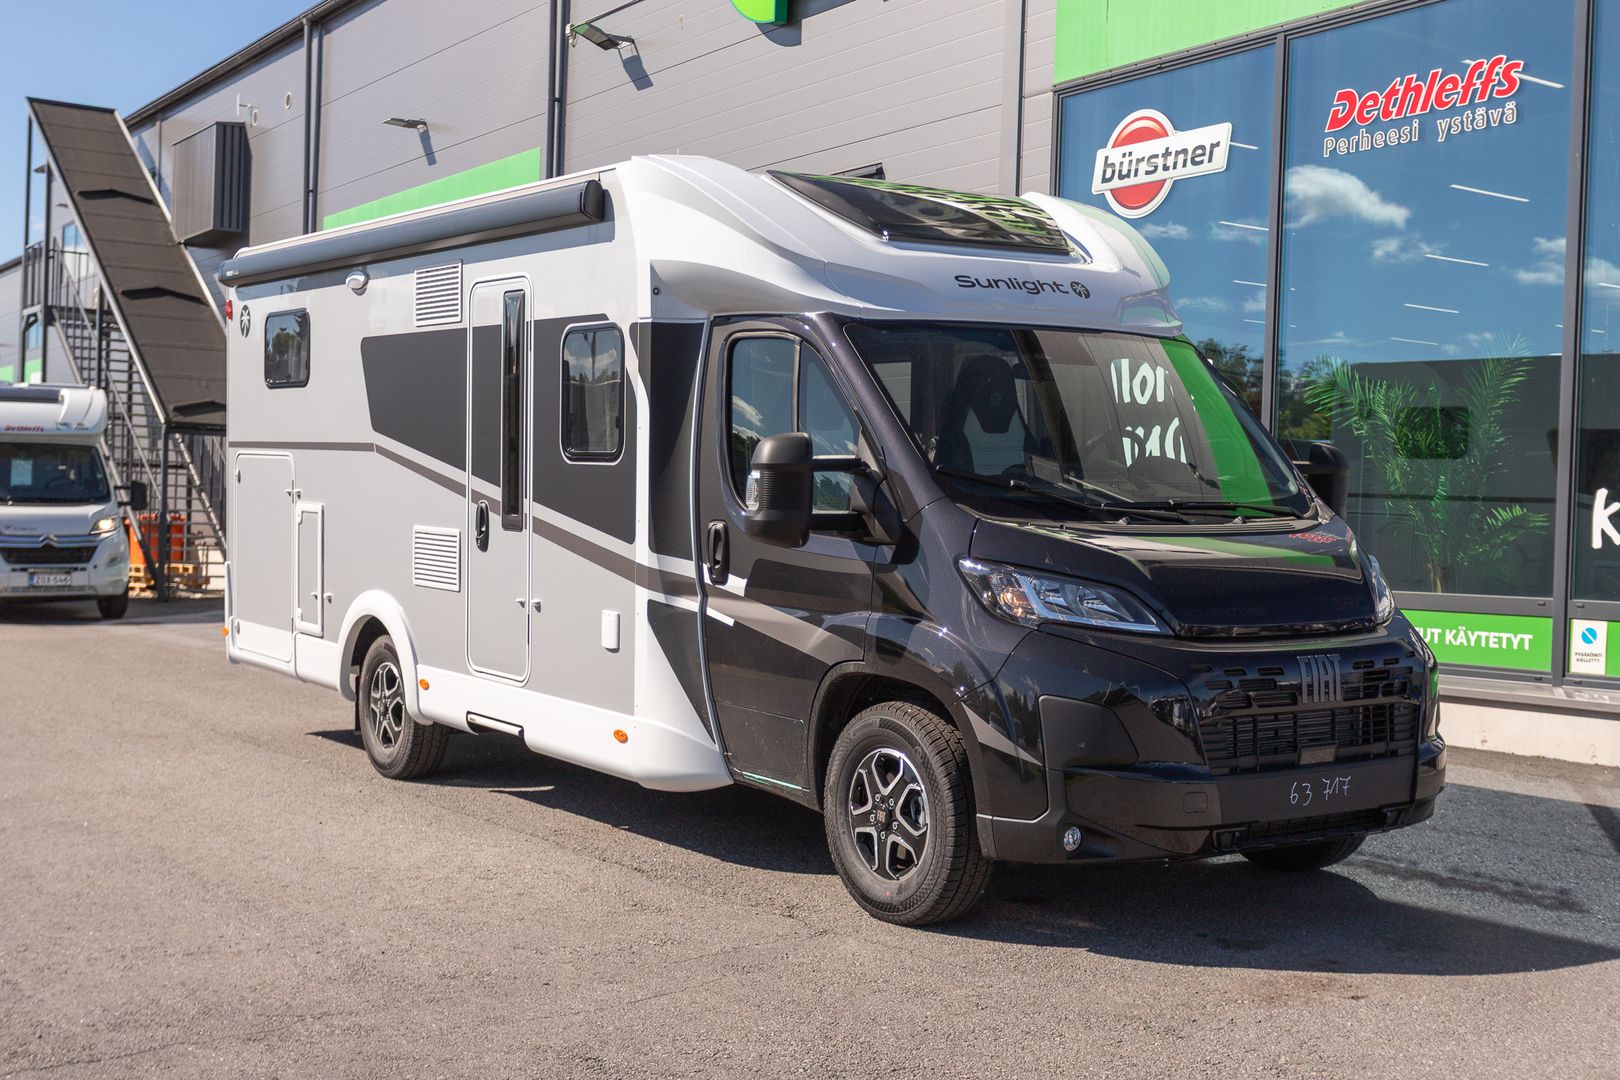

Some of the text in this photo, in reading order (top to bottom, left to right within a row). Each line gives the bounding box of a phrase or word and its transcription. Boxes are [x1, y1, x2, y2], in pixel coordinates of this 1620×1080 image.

[1325, 55, 1524, 132] Dethleffs
[1323, 101, 1517, 157] Perheesi ystävä
[1100, 137, 1221, 184] bürstner
[954, 275, 1069, 295] Sunlight
[1445, 626, 1533, 650] KÄYTETYT
[1297, 654, 1343, 704] FIAT
[1290, 776, 1351, 806] 63 717
